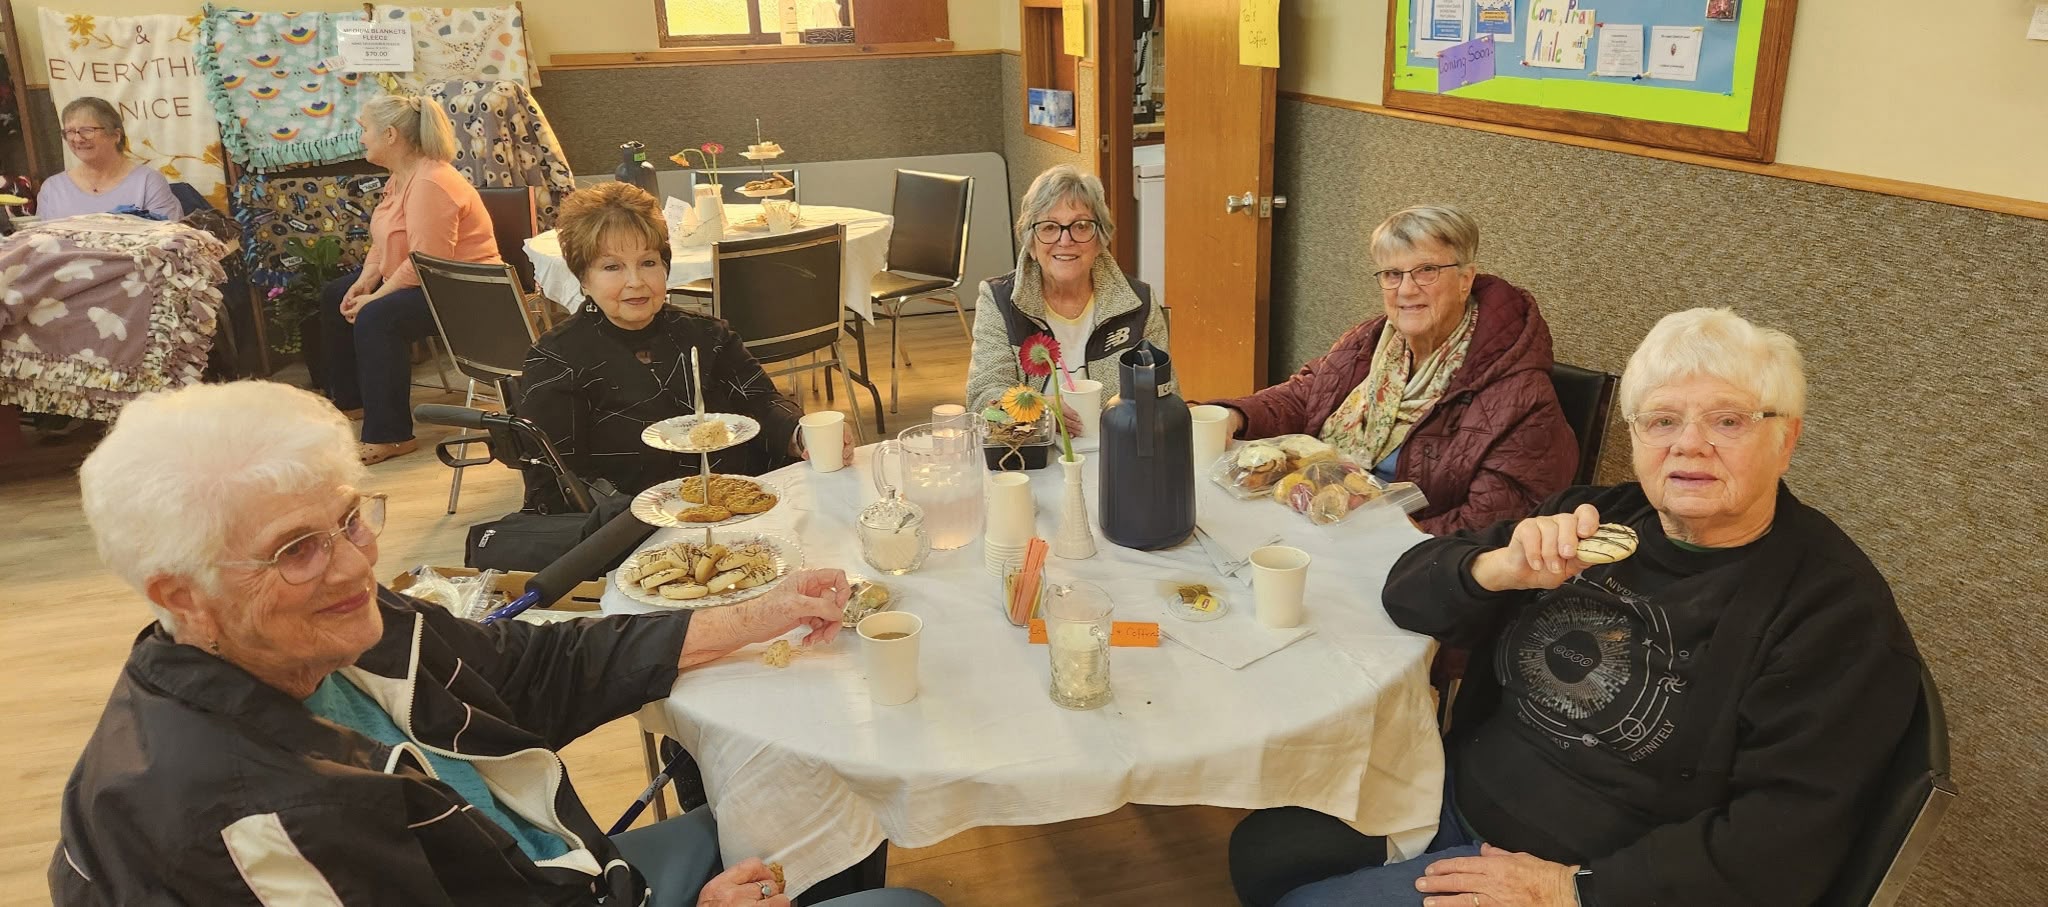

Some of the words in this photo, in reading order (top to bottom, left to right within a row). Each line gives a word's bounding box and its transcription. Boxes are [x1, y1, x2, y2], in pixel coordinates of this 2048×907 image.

[136, 25, 150, 44] &
[48, 56, 197, 83] EVERYTHI
[118, 97, 192, 121] NICE
